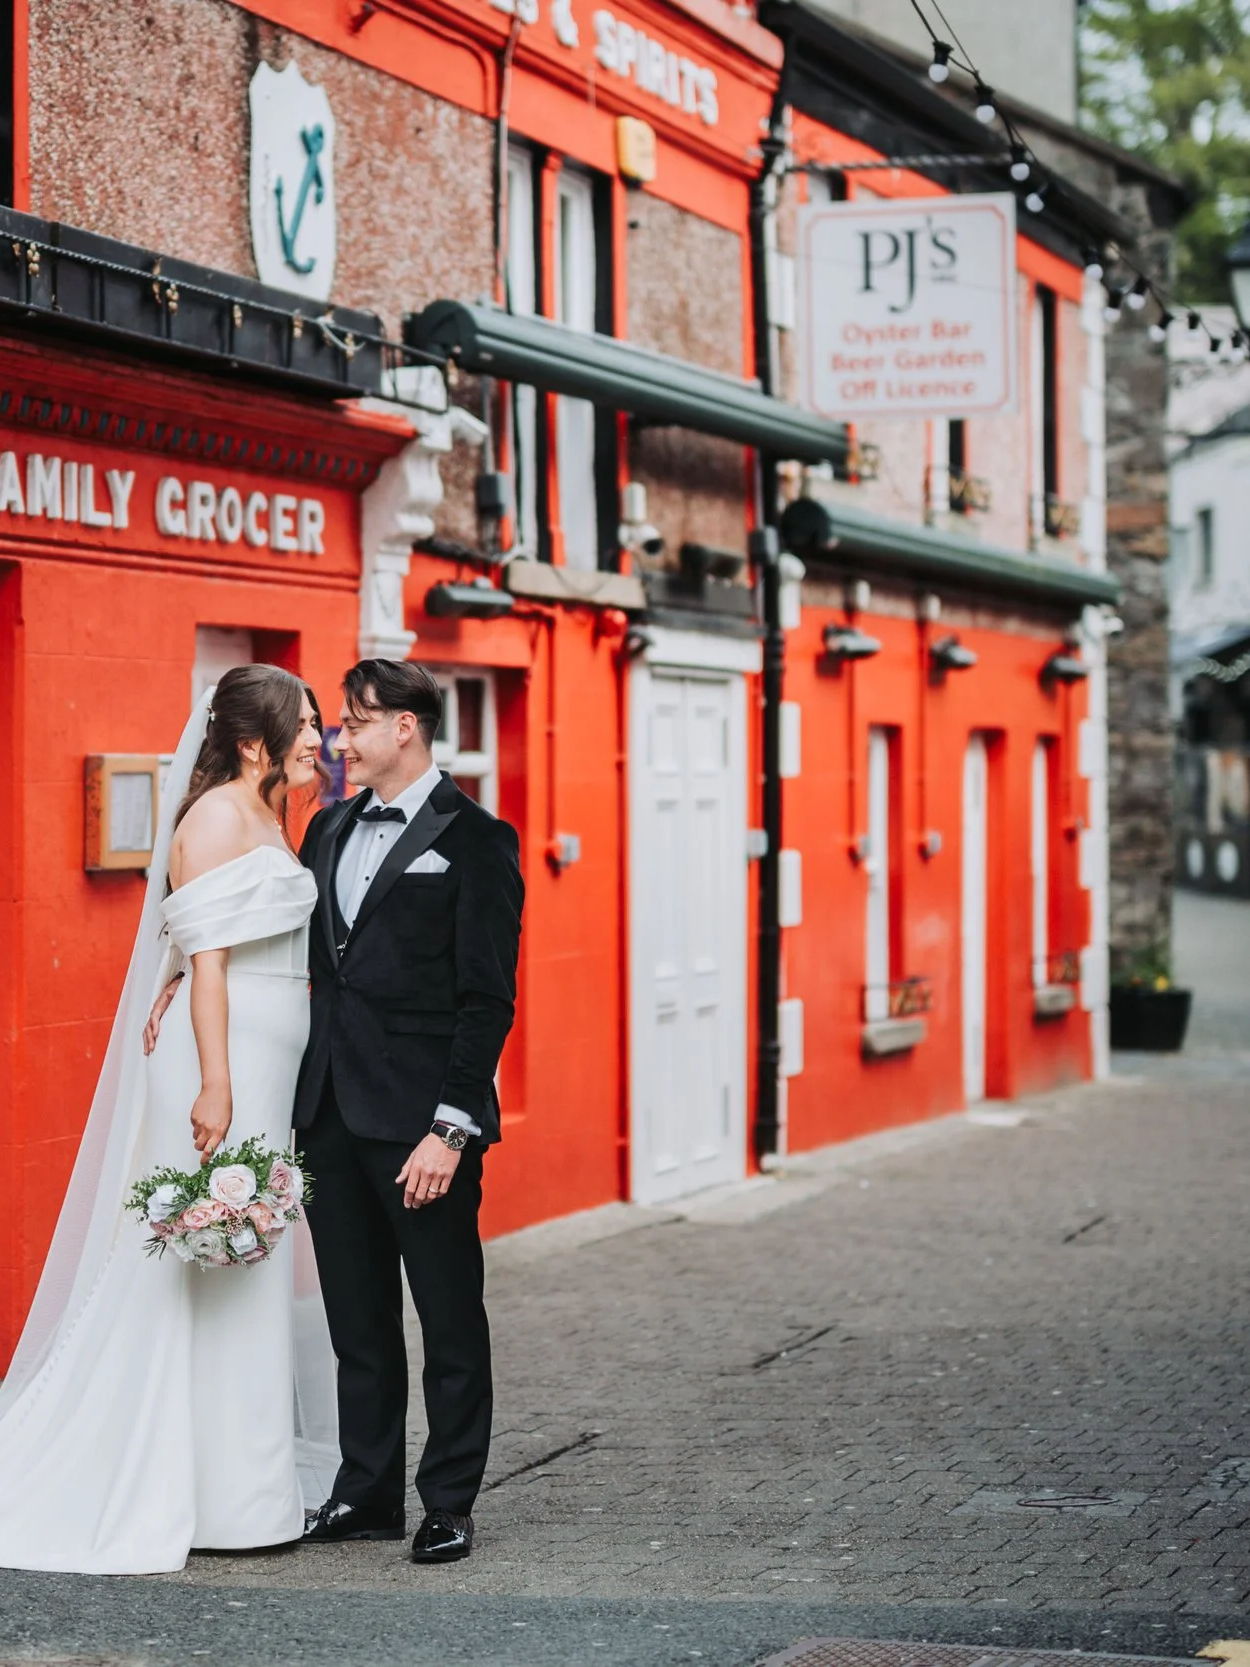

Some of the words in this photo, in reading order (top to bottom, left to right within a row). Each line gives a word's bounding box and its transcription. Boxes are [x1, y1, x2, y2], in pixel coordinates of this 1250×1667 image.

[593, 9, 719, 126] SPIRITS
[843, 323, 921, 347] Oyster
[931, 319, 971, 340] Bar
[832, 353, 884, 372] Beer
[894, 347, 985, 369] Garden
[840, 380, 878, 402] Off
[886, 379, 976, 399] Licence
[155, 476, 325, 554] GROCER
